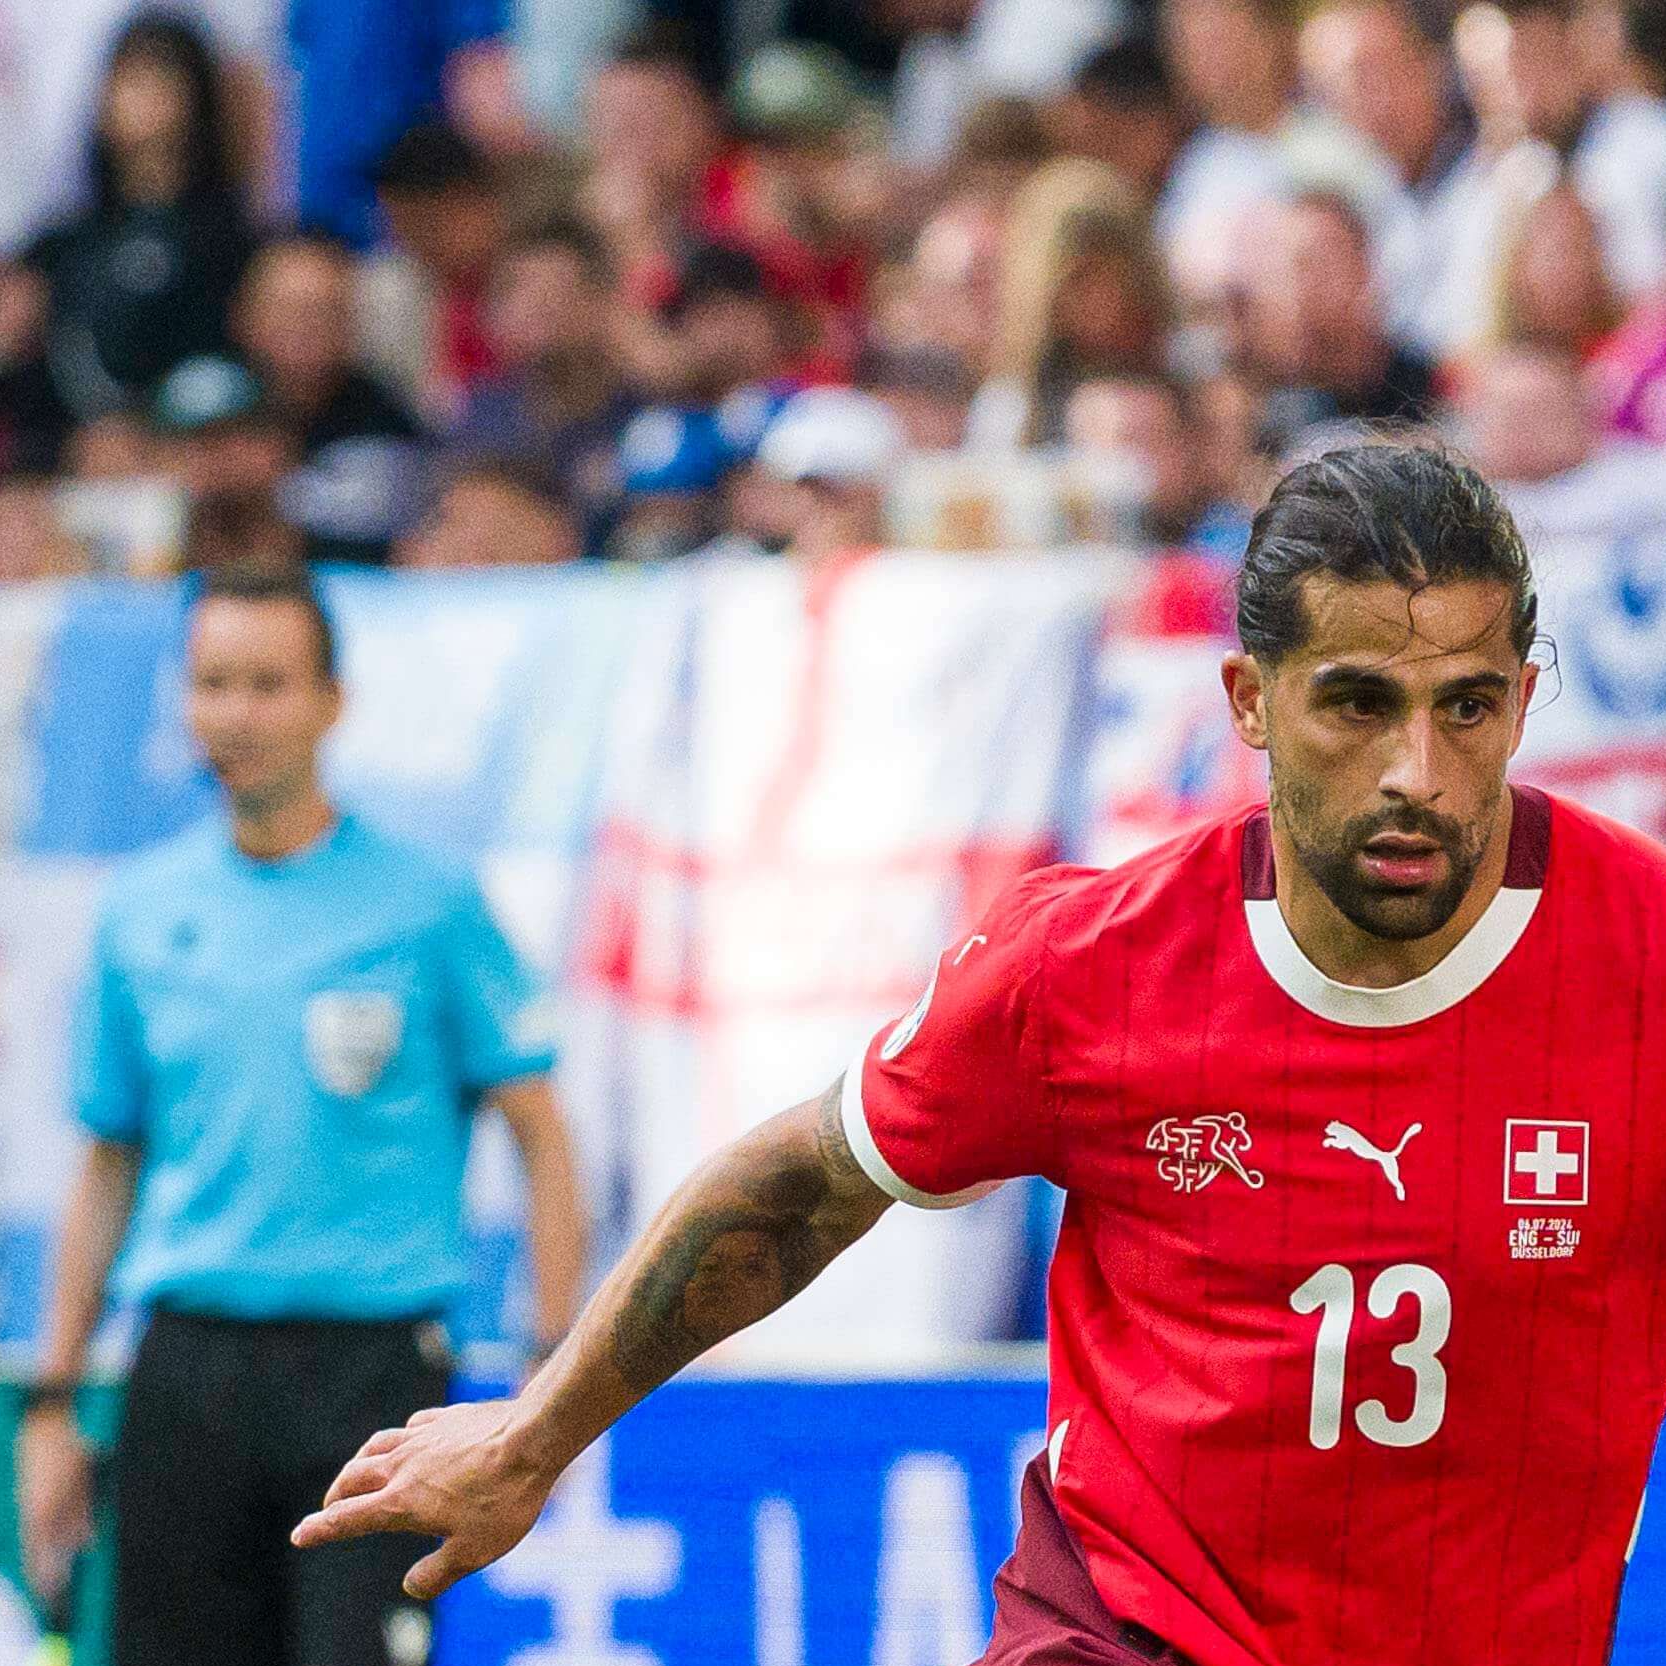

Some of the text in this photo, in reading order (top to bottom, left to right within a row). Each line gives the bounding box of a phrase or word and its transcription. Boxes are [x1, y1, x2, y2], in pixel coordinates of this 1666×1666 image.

[1508, 1229, 1539, 1247] ENG
[1556, 1229, 1581, 1246] SUI
[1289, 1264, 1452, 1450] 13
